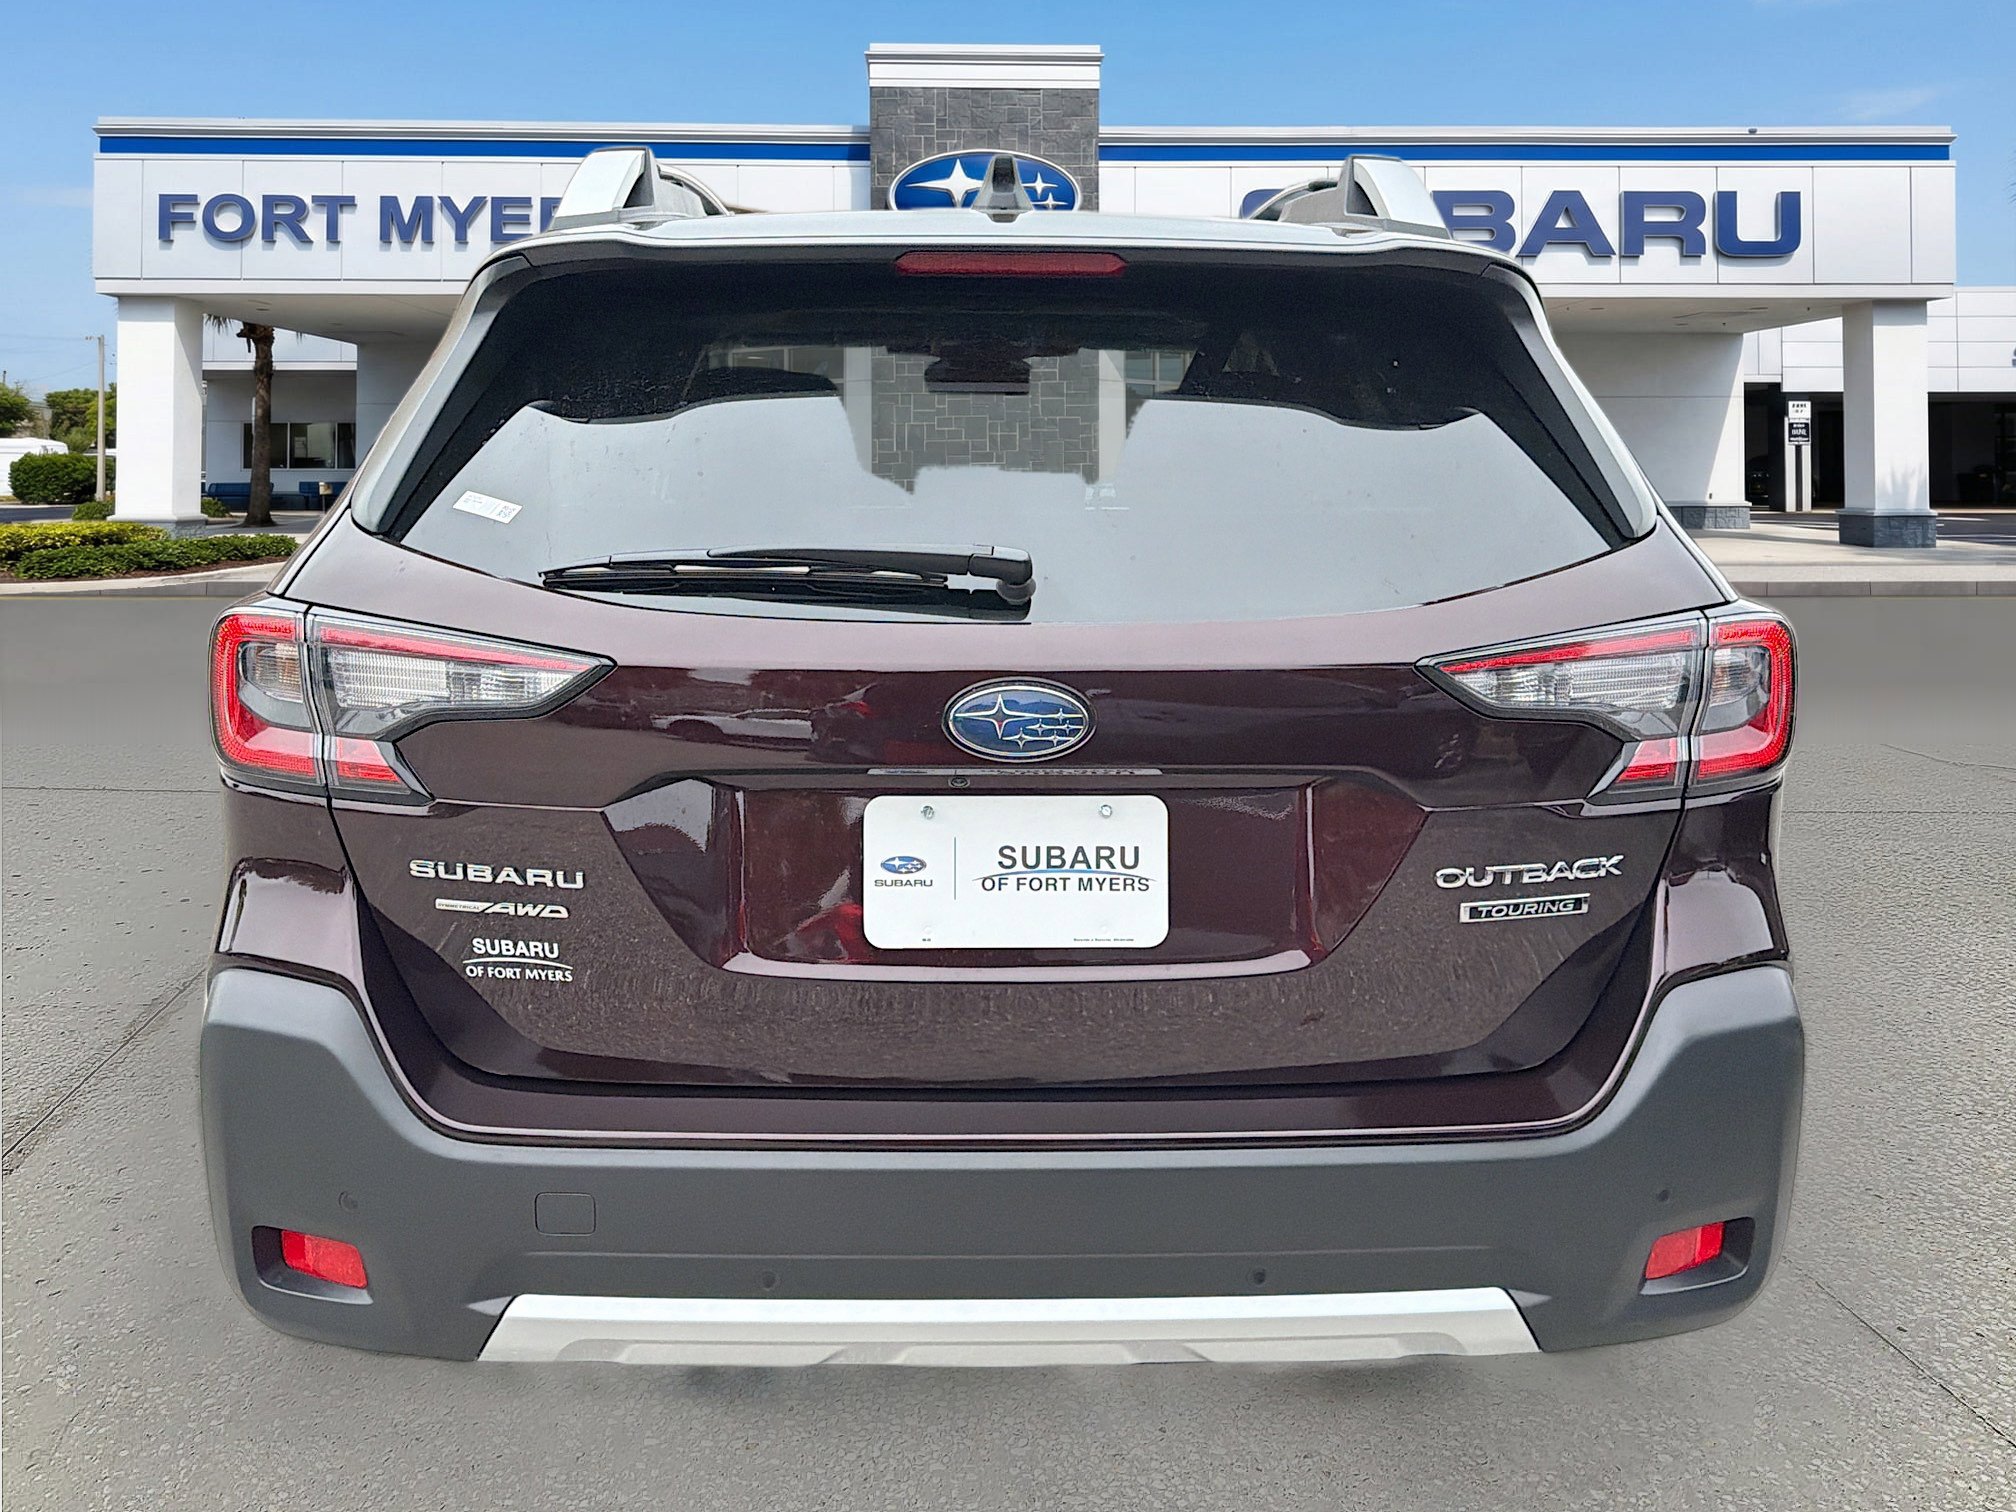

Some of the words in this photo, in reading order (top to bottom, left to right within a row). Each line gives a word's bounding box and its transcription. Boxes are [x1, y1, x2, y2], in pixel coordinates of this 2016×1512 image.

[158, 192, 358, 243] FORT
[379, 194, 564, 245] MYE
[1240, 188, 1802, 258] BARU
[998, 845, 1140, 870] SUBARU
[409, 859, 585, 890] SUBARU
[1435, 854, 1625, 889] OUTBACK
[874, 878, 934, 888] SUBARU
[981, 877, 1009, 892] OF
[1016, 877, 1069, 892] FORT
[1078, 877, 1150, 892] MYERS
[484, 902, 570, 919] AWD
[1477, 899, 1576, 919] TOURING
[472, 937, 560, 959] SUBARU
[465, 965, 485, 978] OF
[488, 966, 522, 980] FORT
[525, 968, 573, 983] MYERS
